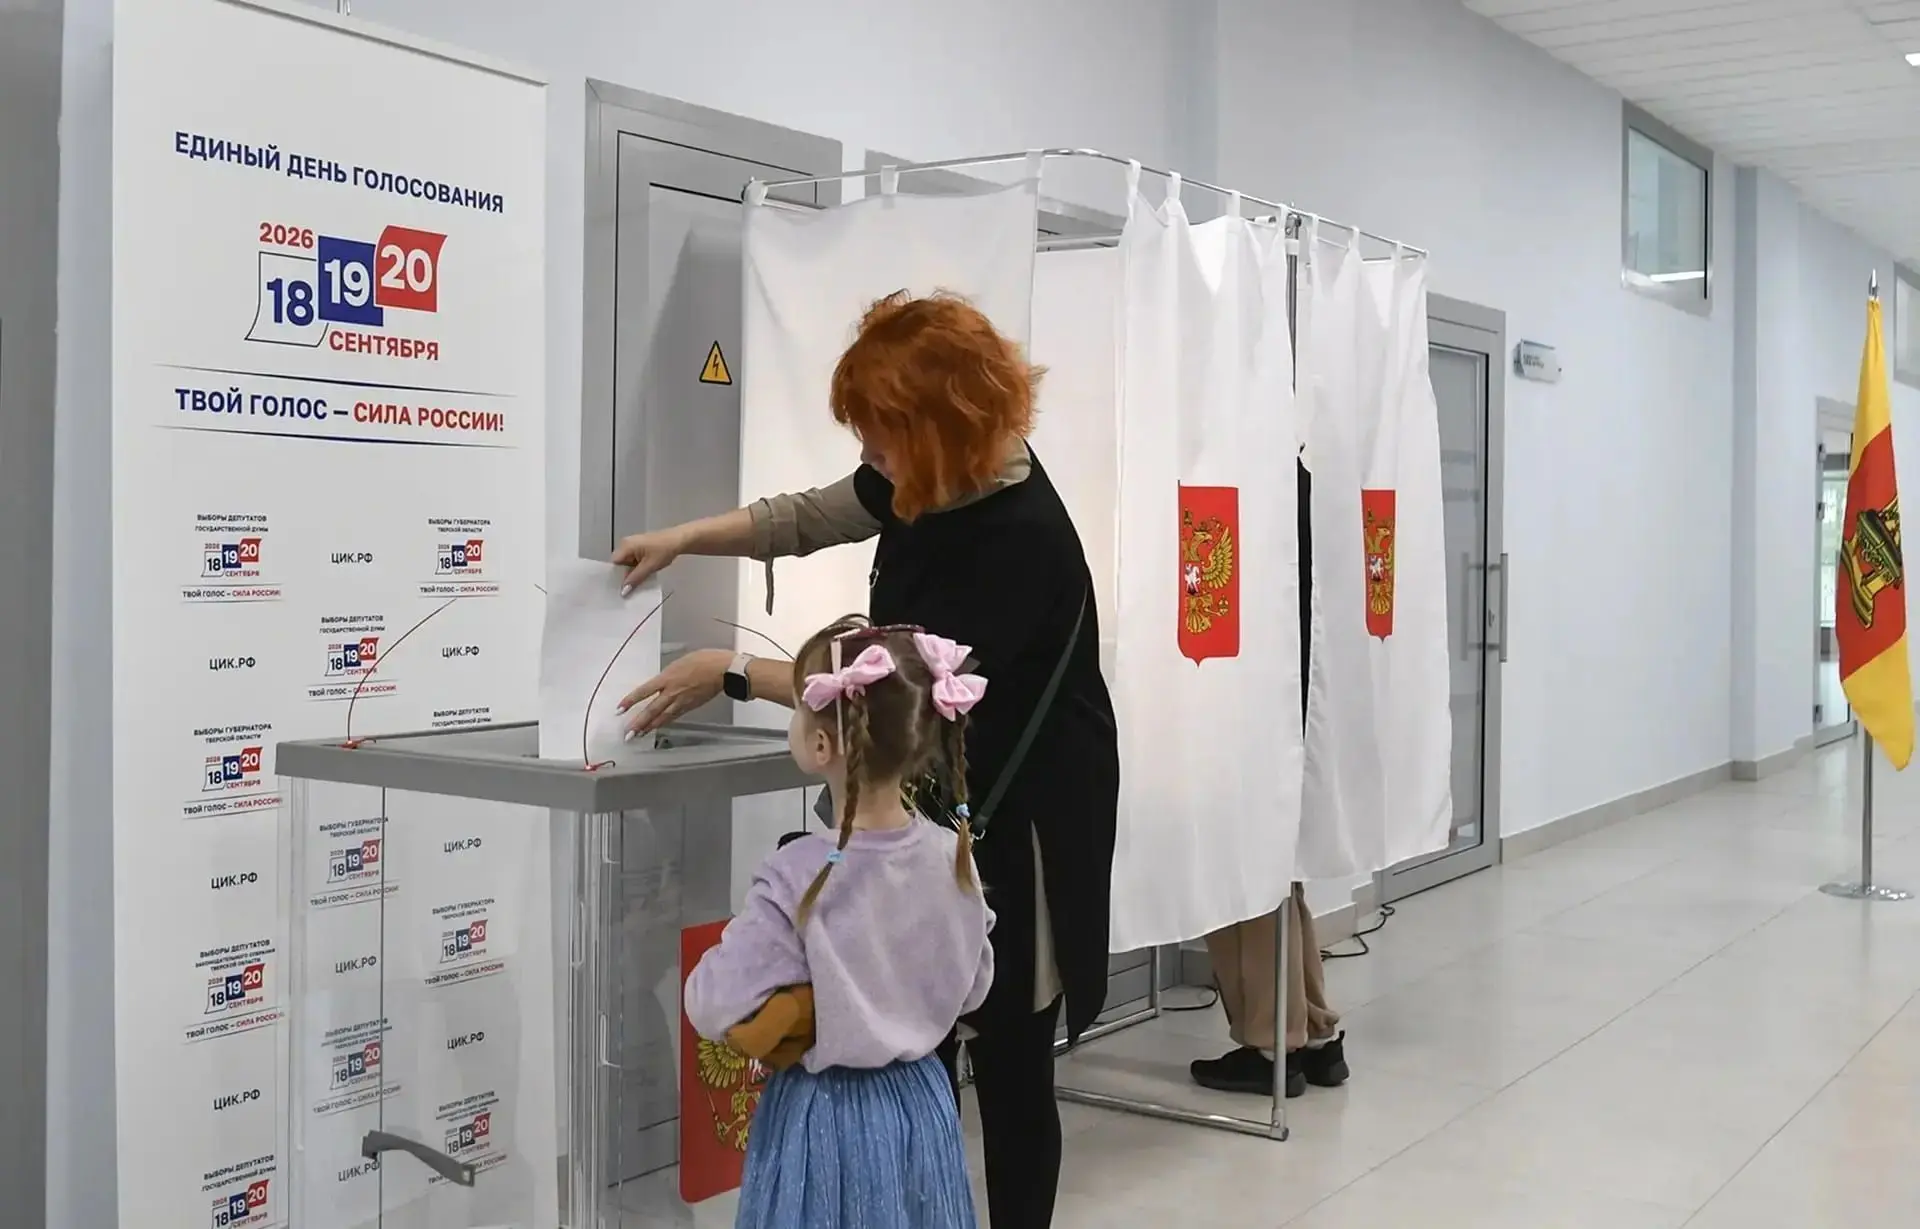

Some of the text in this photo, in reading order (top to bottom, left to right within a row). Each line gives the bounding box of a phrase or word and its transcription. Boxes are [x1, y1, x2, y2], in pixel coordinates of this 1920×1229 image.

[175, 131, 504, 213] ЕДИНЫЙ ДЕНЬ ГОЛОСОВАНИЯ
[259, 222, 314, 249] 2026
[266, 244, 433, 327] 18 19 20
[329, 331, 438, 361] СЕНТЯБРЯ
[175, 388, 242, 414] ТВОЙ
[250, 394, 327, 419] ГОЛОС
[354, 402, 411, 426] СИЛА
[418, 407, 504, 432] РОССИИ!
[207, 544, 257, 571] 18 19 20
[332, 552, 373, 564] ЦИК.РФ
[440, 545, 480, 569] 18 19 20
[321, 615, 383, 624] ВЫБОРЫ ДЕПУТАТОВ
[209, 657, 256, 671] ЦИК.РФ
[330, 643, 375, 670] 18 19 20
[443, 646, 480, 658] ЦИК.РФ
[194, 724, 272, 736] ВЫБОРЫ ГУБЕРНАТОРА
[208, 754, 258, 785] 18 19 20
[184, 805, 202, 814] ТВОЙ
[204, 803, 226, 812] ГОЛОС
[234, 800, 252, 809] СИЛА
[444, 838, 481, 853] ЦИК.РФ
[333, 845, 377, 877] 18 19 20
[212, 872, 257, 890] ЦИК.РФ
[200, 939, 270, 958] ВЫБОРЫ ДЕПУТАТОВ
[444, 925, 484, 957] 18 19 20
[336, 956, 376, 973] ЦИК.РФ
[211, 971, 260, 1006] 18 19 20
[447, 1032, 484, 1050] ЦИК.РФ
[335, 1069, 348, 1083] 18
[350, 1058, 362, 1072] 19
[366, 1048, 380, 1061] 20
[214, 1089, 260, 1110] ЦИК.РФ
[447, 1141, 459, 1154] 18
[461, 1130, 471, 1143] 19
[474, 1119, 487, 1132] 20
[215, 1186, 265, 1228] 18 19 20
